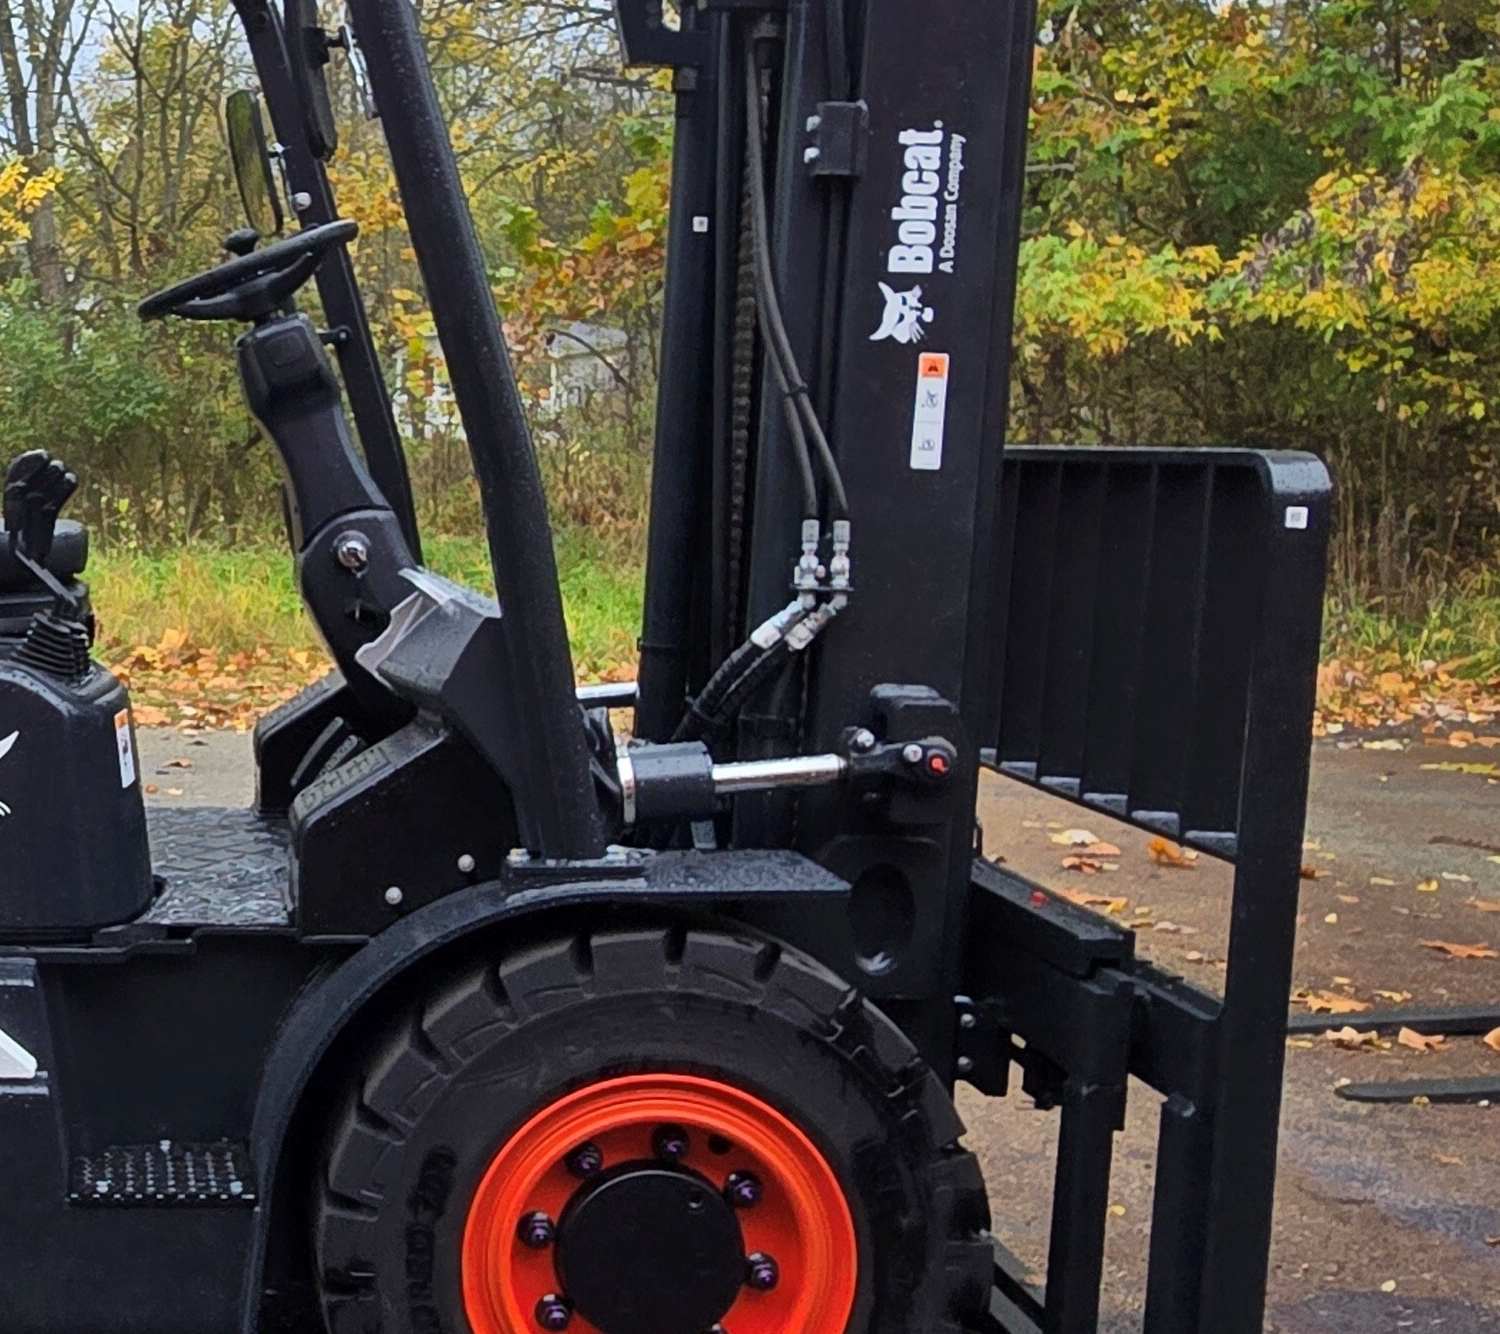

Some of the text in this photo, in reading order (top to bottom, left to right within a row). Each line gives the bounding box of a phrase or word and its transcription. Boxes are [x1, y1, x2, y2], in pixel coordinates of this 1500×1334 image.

[939, 133, 966, 273] A Doosan Company
